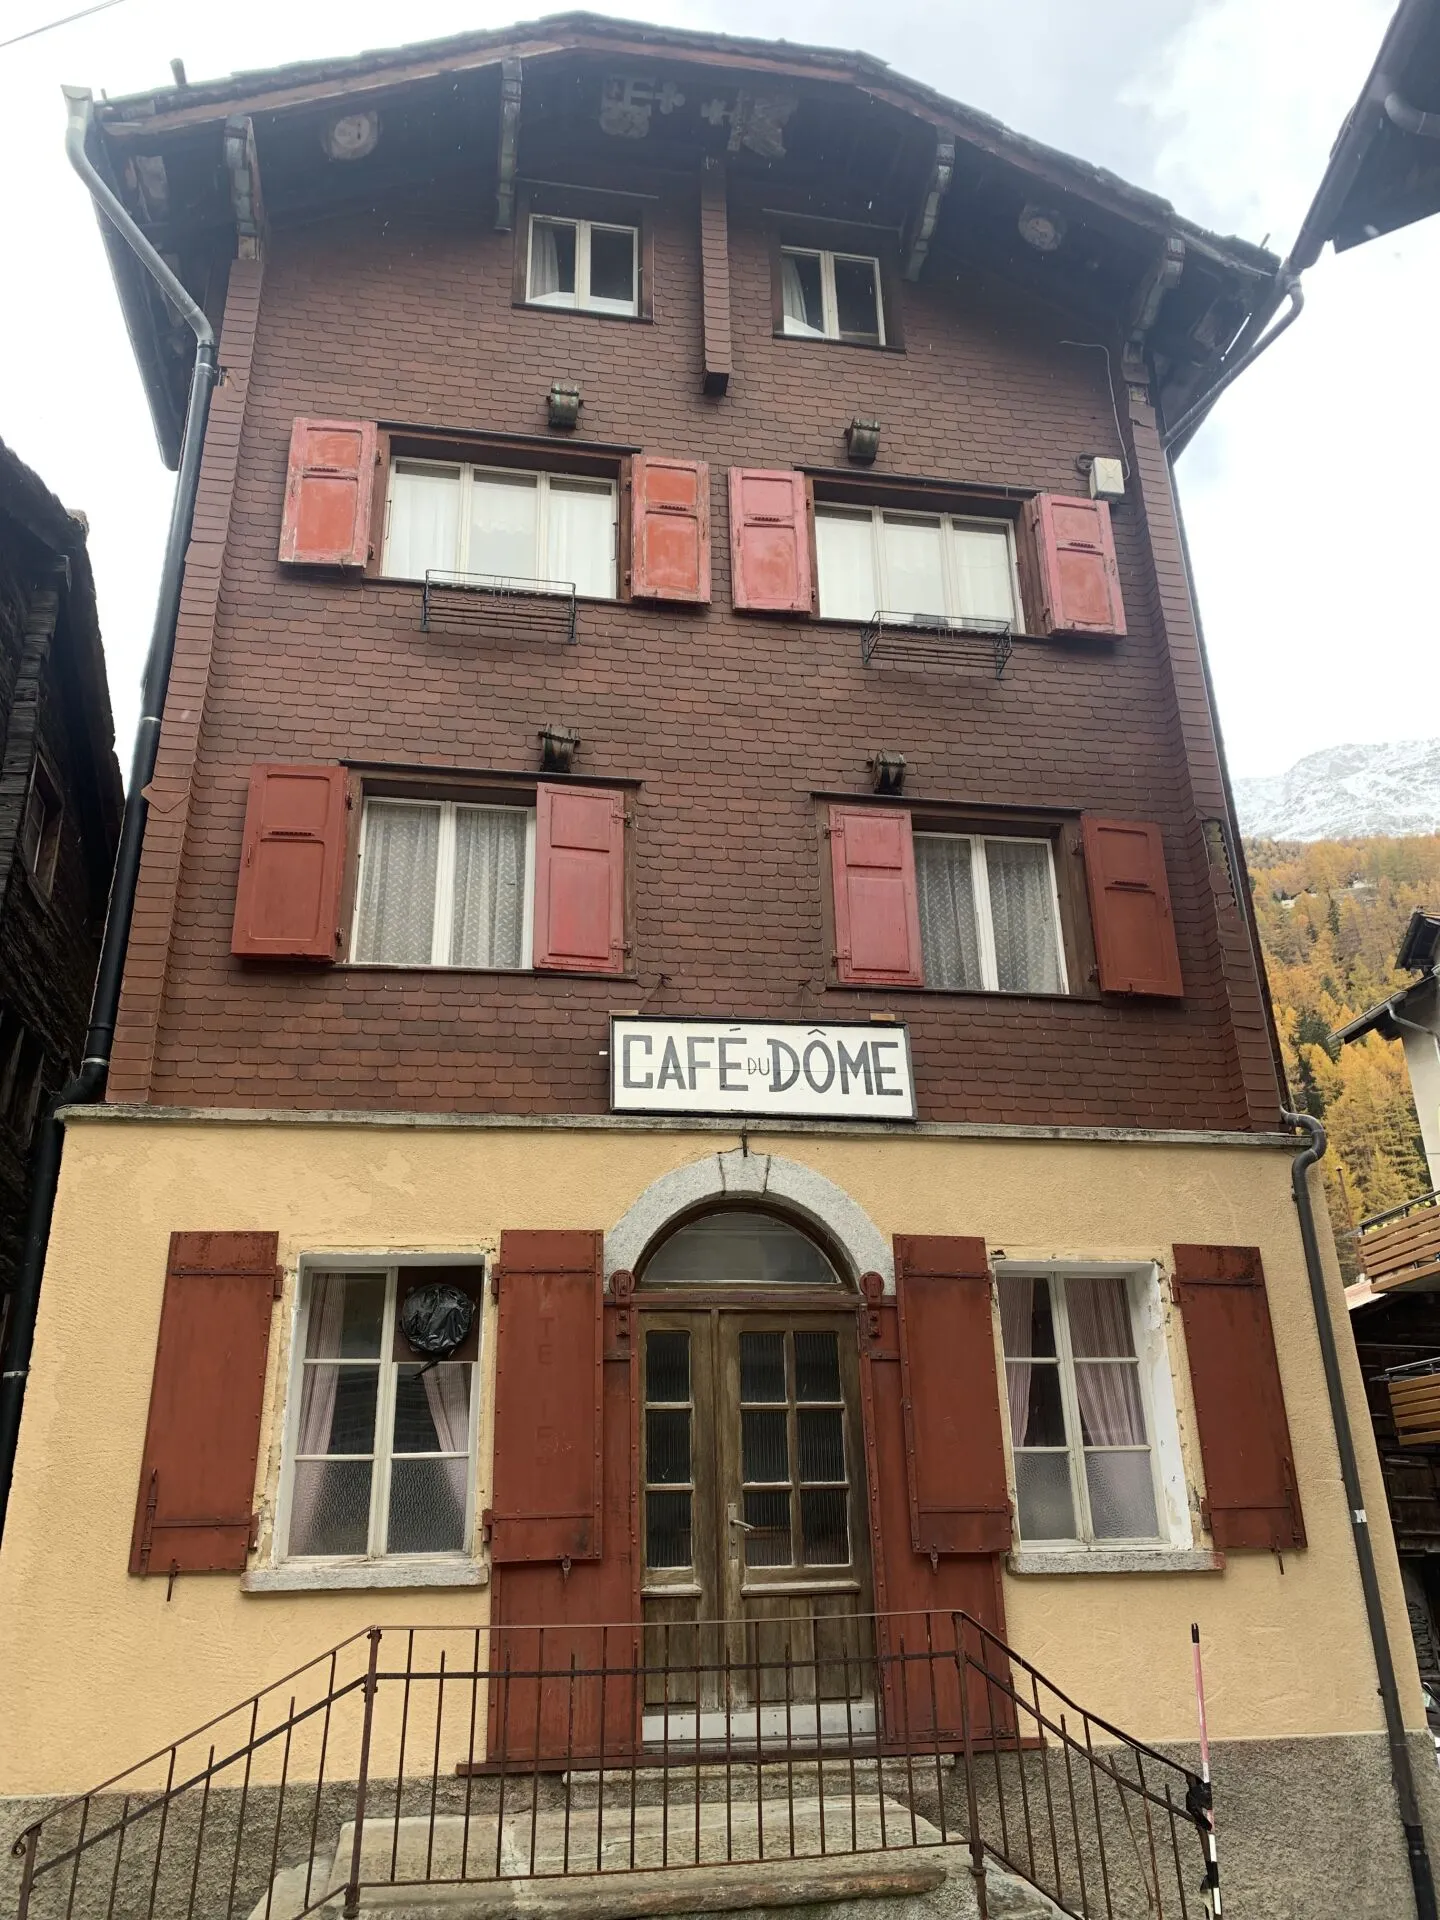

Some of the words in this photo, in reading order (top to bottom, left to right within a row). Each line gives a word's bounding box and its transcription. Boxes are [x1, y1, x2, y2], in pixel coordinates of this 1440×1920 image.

[622, 1027, 749, 1091] CAFÉ
[747, 1056, 770, 1076] DU
[766, 1028, 904, 1096] DÔME
